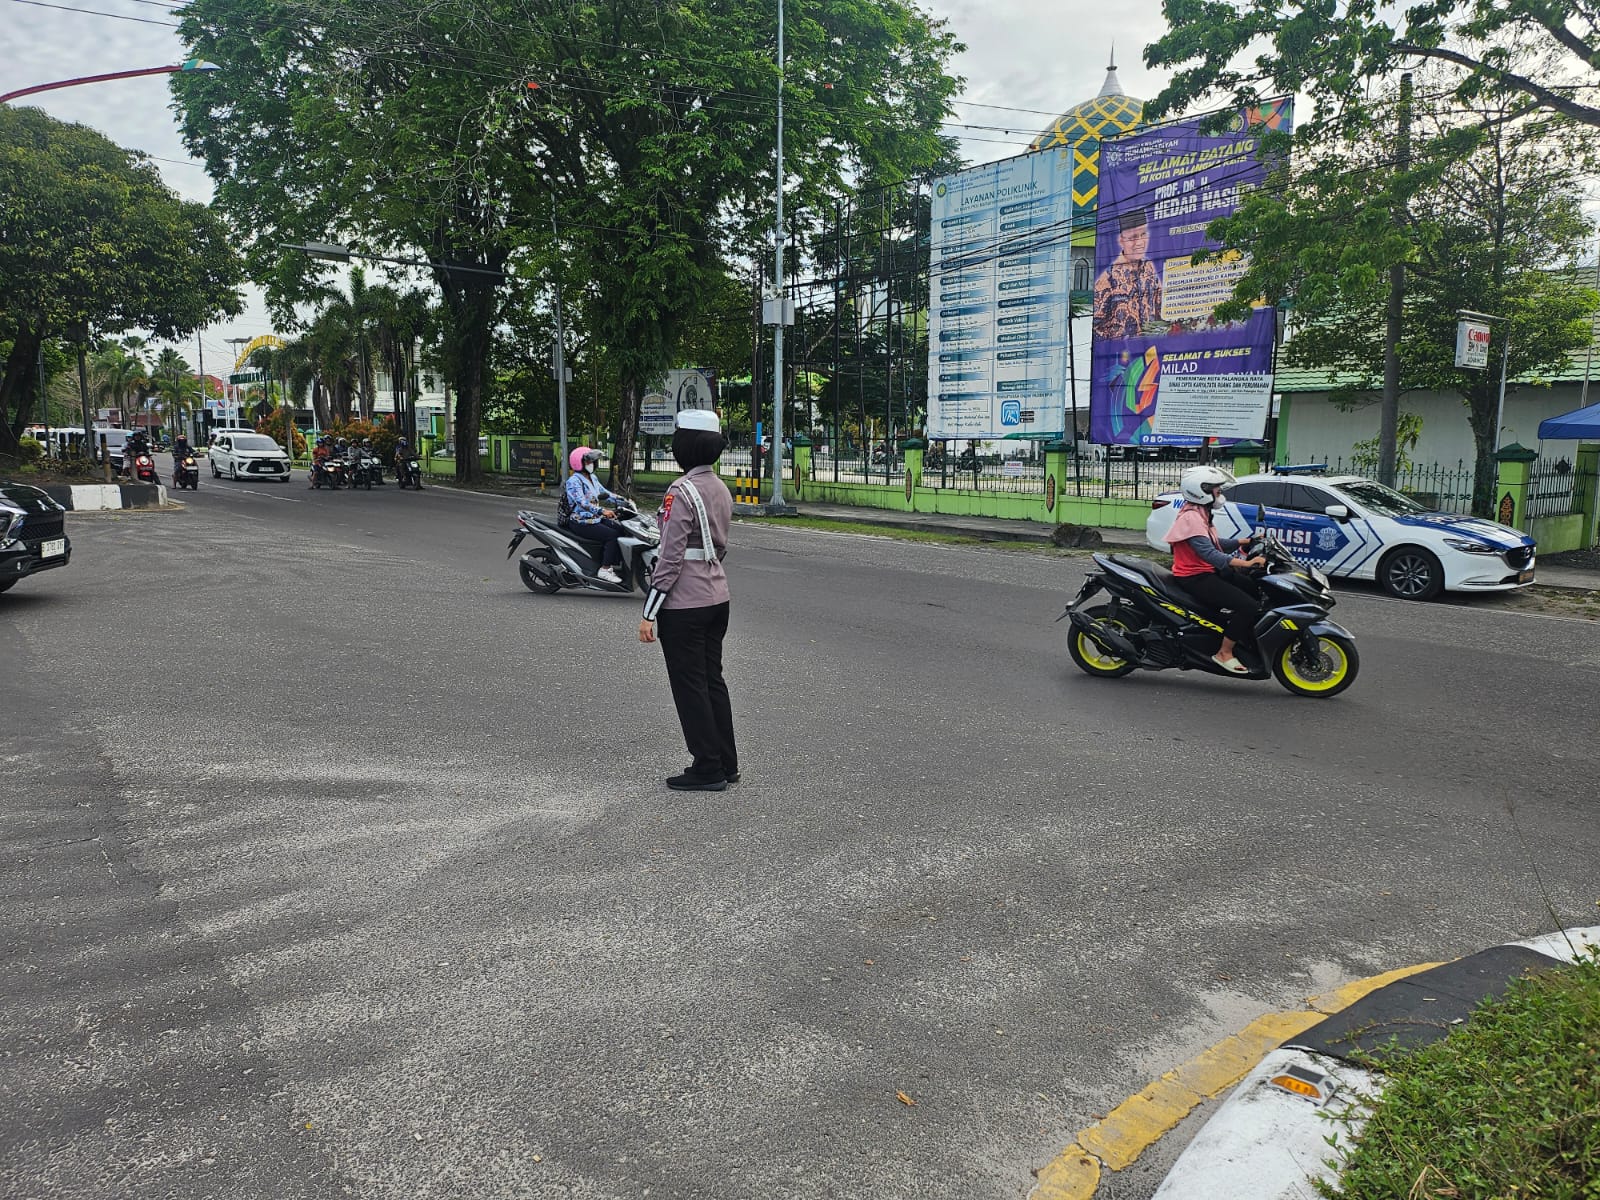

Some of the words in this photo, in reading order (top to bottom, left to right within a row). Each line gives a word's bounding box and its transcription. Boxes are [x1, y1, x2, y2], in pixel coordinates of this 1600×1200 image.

[1138, 152, 1198, 176] SELAMAT
[1199, 139, 1254, 161] DATANG
[1140, 175, 1148, 184] DI
[1149, 171, 1171, 181] KOTA
[1173, 160, 1220, 177] PALANGKA
[961, 191, 995, 206] LAYANAN
[997, 180, 1038, 198] POLIKLINIK
[1155, 182, 1180, 200] PROF.
[1468, 328, 1492, 343] Canon
[1162, 353, 1202, 362] SELAMAT
[1213, 348, 1252, 358] SUKSES
[1161, 362, 1198, 374] MILAD
[1254, 526, 1312, 545] POLISI
